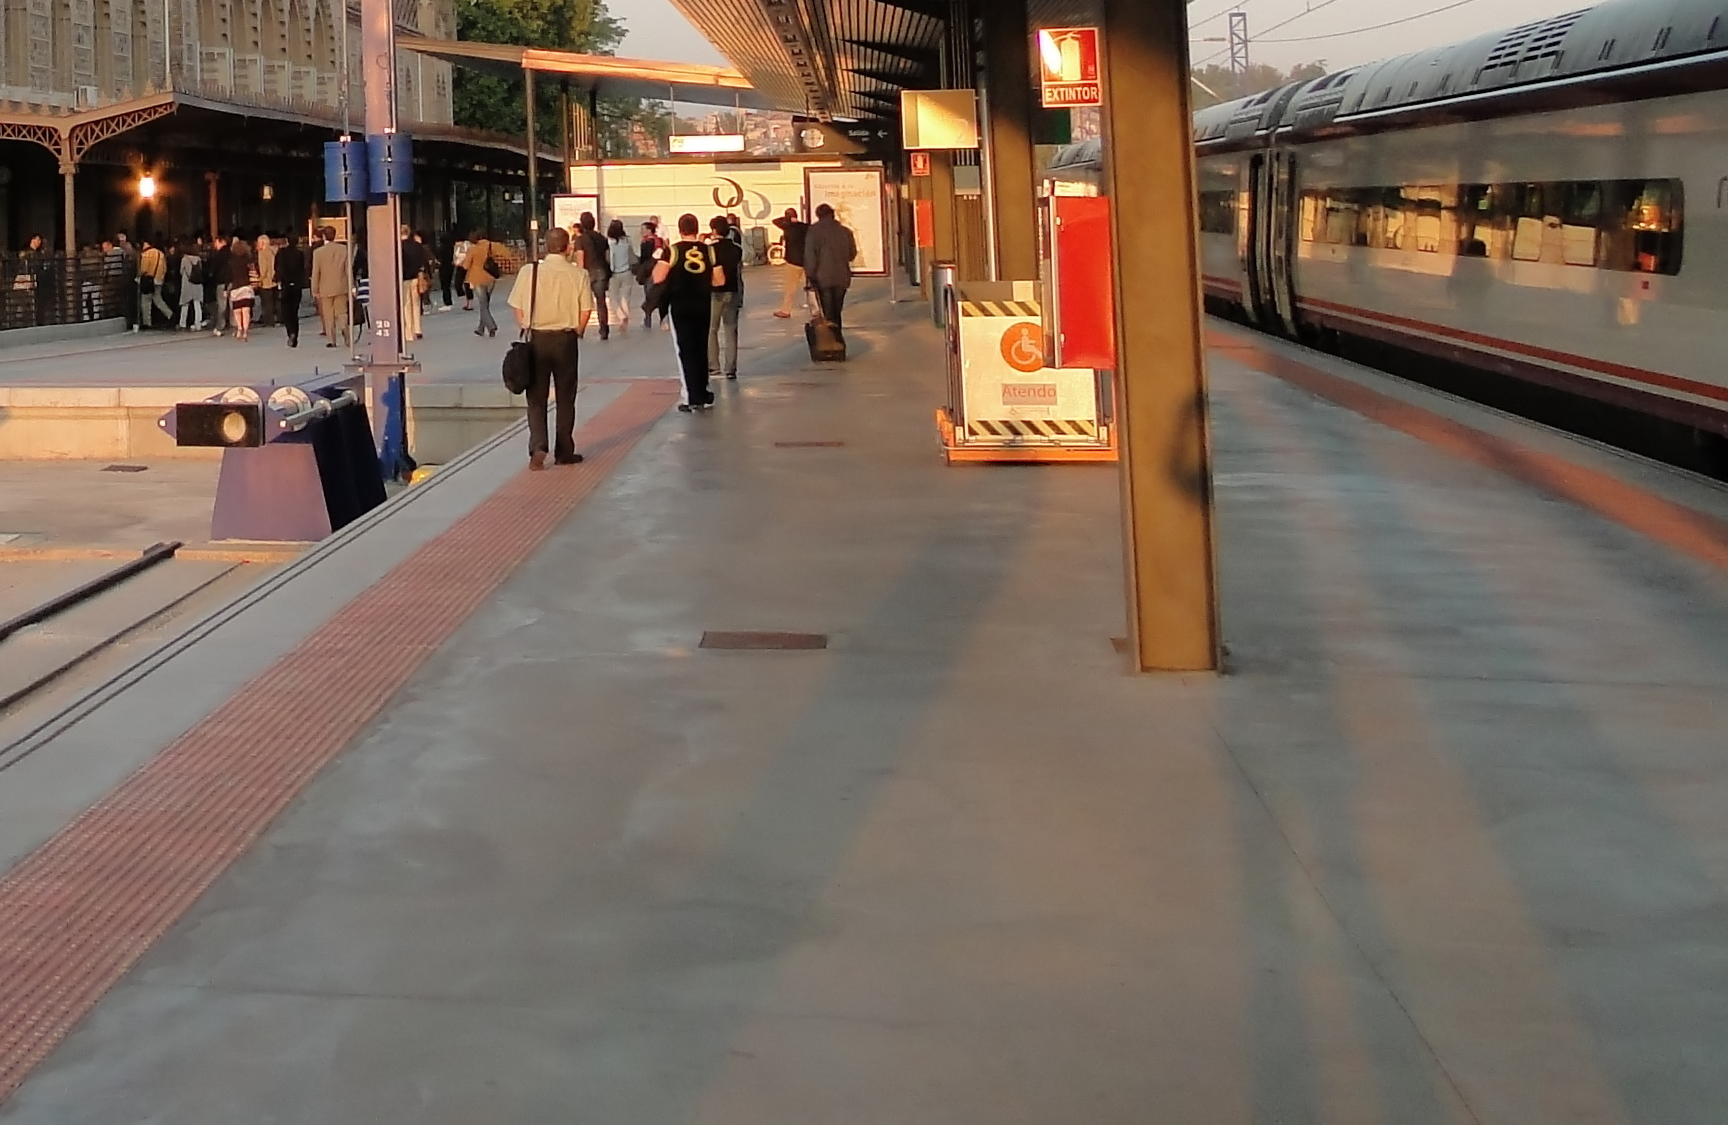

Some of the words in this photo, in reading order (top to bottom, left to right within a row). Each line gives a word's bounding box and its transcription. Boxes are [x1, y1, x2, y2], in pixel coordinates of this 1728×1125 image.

[1045, 86, 1098, 103] EXTINTOR
[684, 248, 706, 274] 8
[1002, 384, 1057, 398] Atendo
